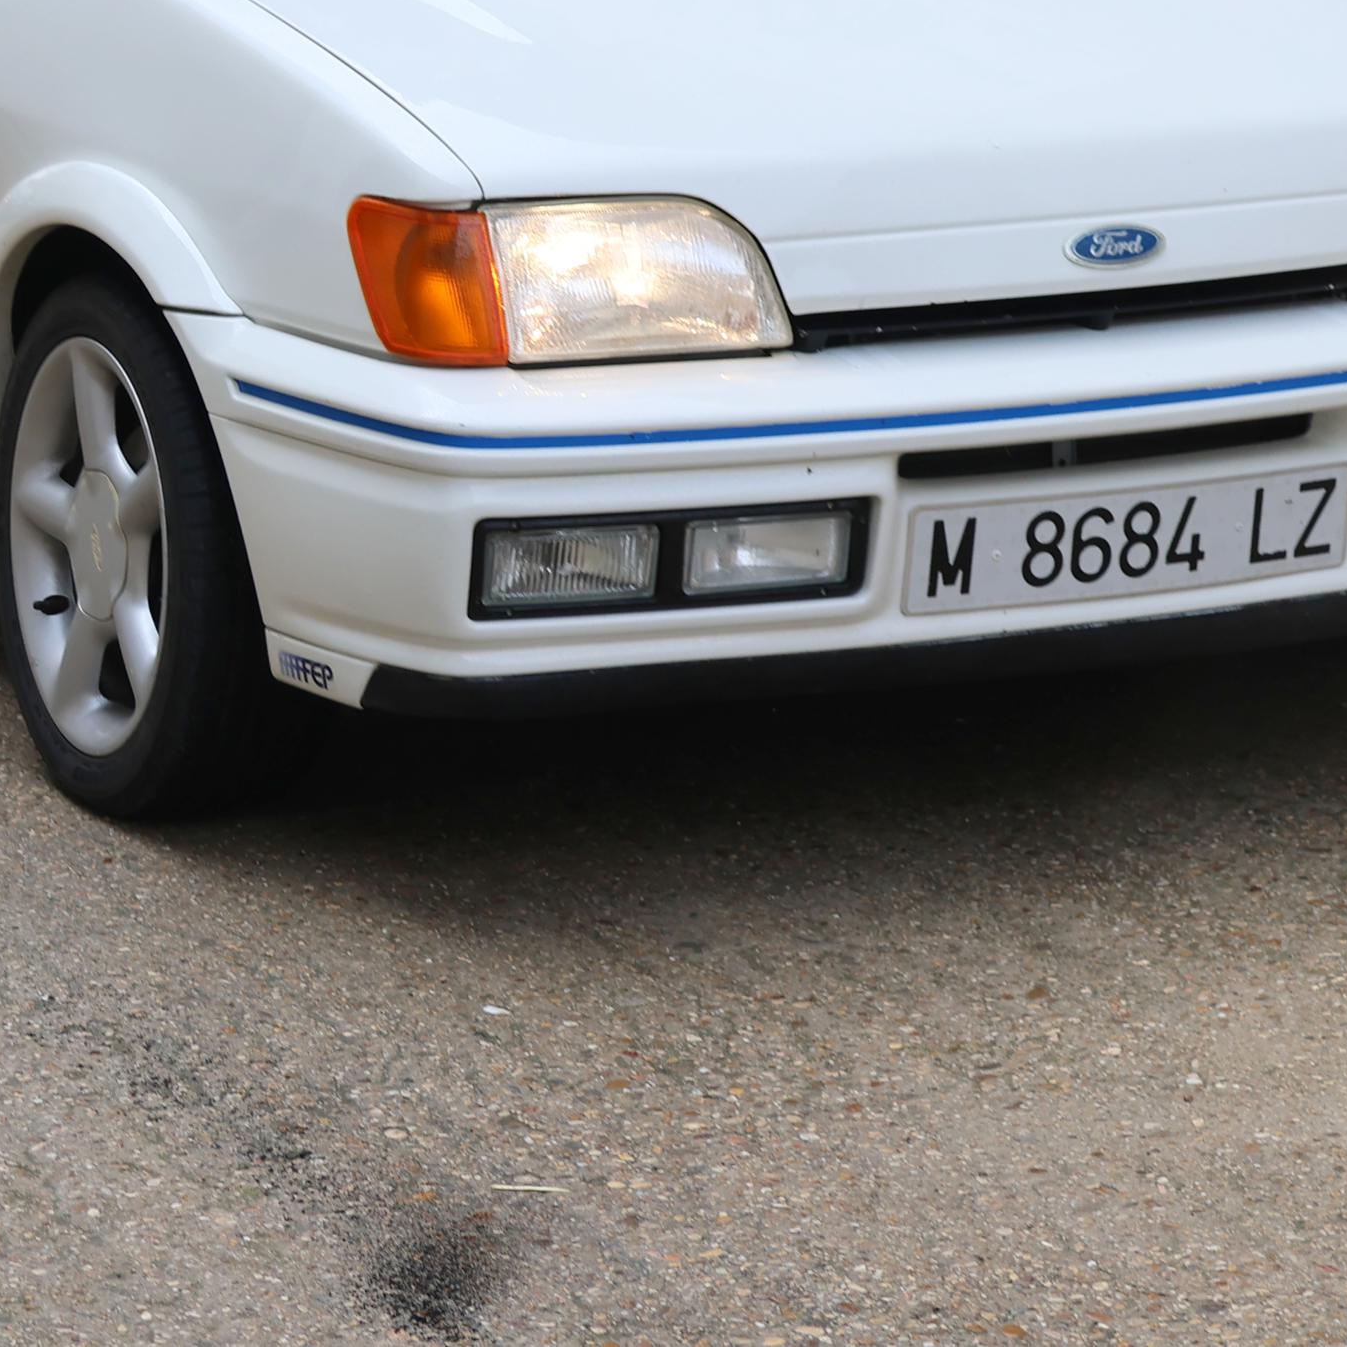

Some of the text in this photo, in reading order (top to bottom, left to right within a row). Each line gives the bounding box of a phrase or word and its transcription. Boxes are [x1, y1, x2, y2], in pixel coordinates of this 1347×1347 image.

[1089, 231, 1144, 258] Ford
[927, 478, 1337, 598] M 8684 LZ
